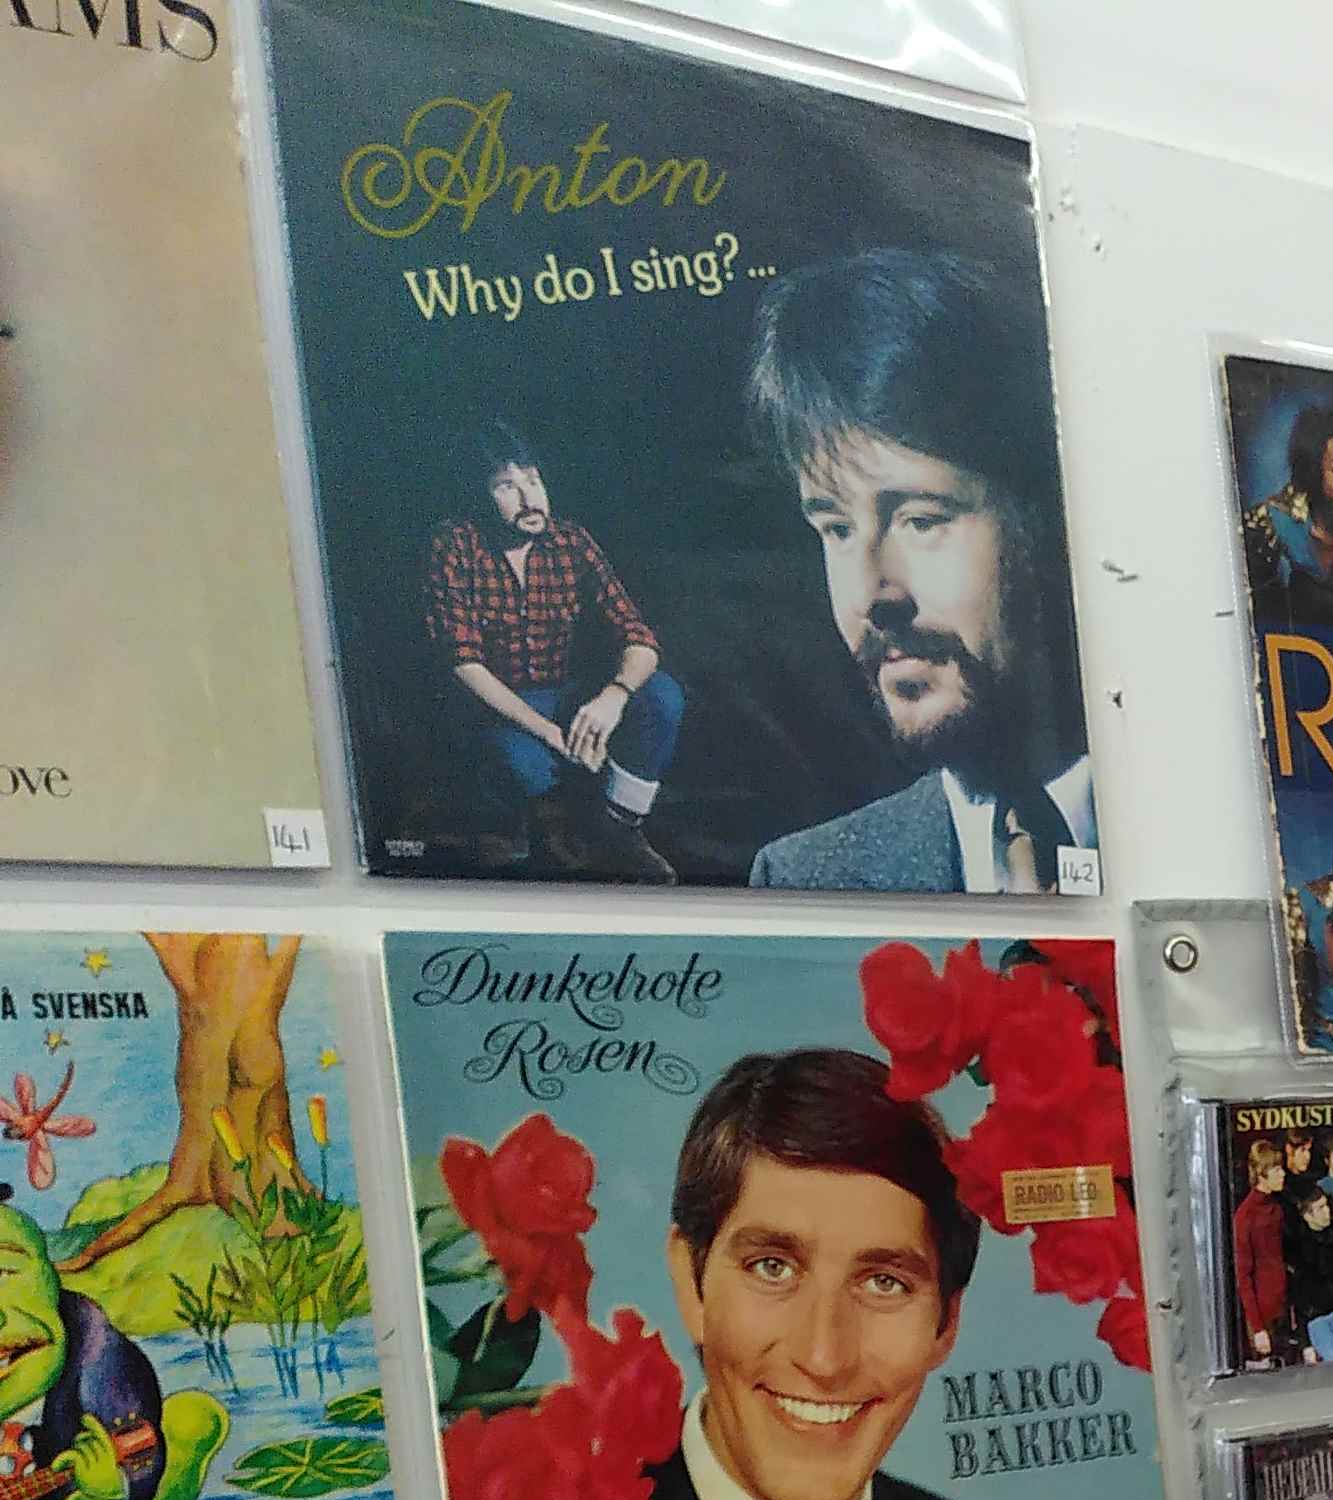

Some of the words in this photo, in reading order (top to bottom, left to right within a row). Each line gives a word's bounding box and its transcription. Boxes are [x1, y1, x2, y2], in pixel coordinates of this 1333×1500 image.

[341, 89, 727, 238] Anton
[404, 264, 523, 321] Why
[533, 254, 595, 305] do
[600, 247, 622, 296] I
[272, 824, 311, 854] 141
[1061, 861, 1094, 882] 142
[33, 991, 149, 1020] SVENSKA
[464, 1018, 699, 1100] Rosen
[943, 1360, 1103, 1423] MARCO
[948, 1410, 1136, 1480] BAKKER
